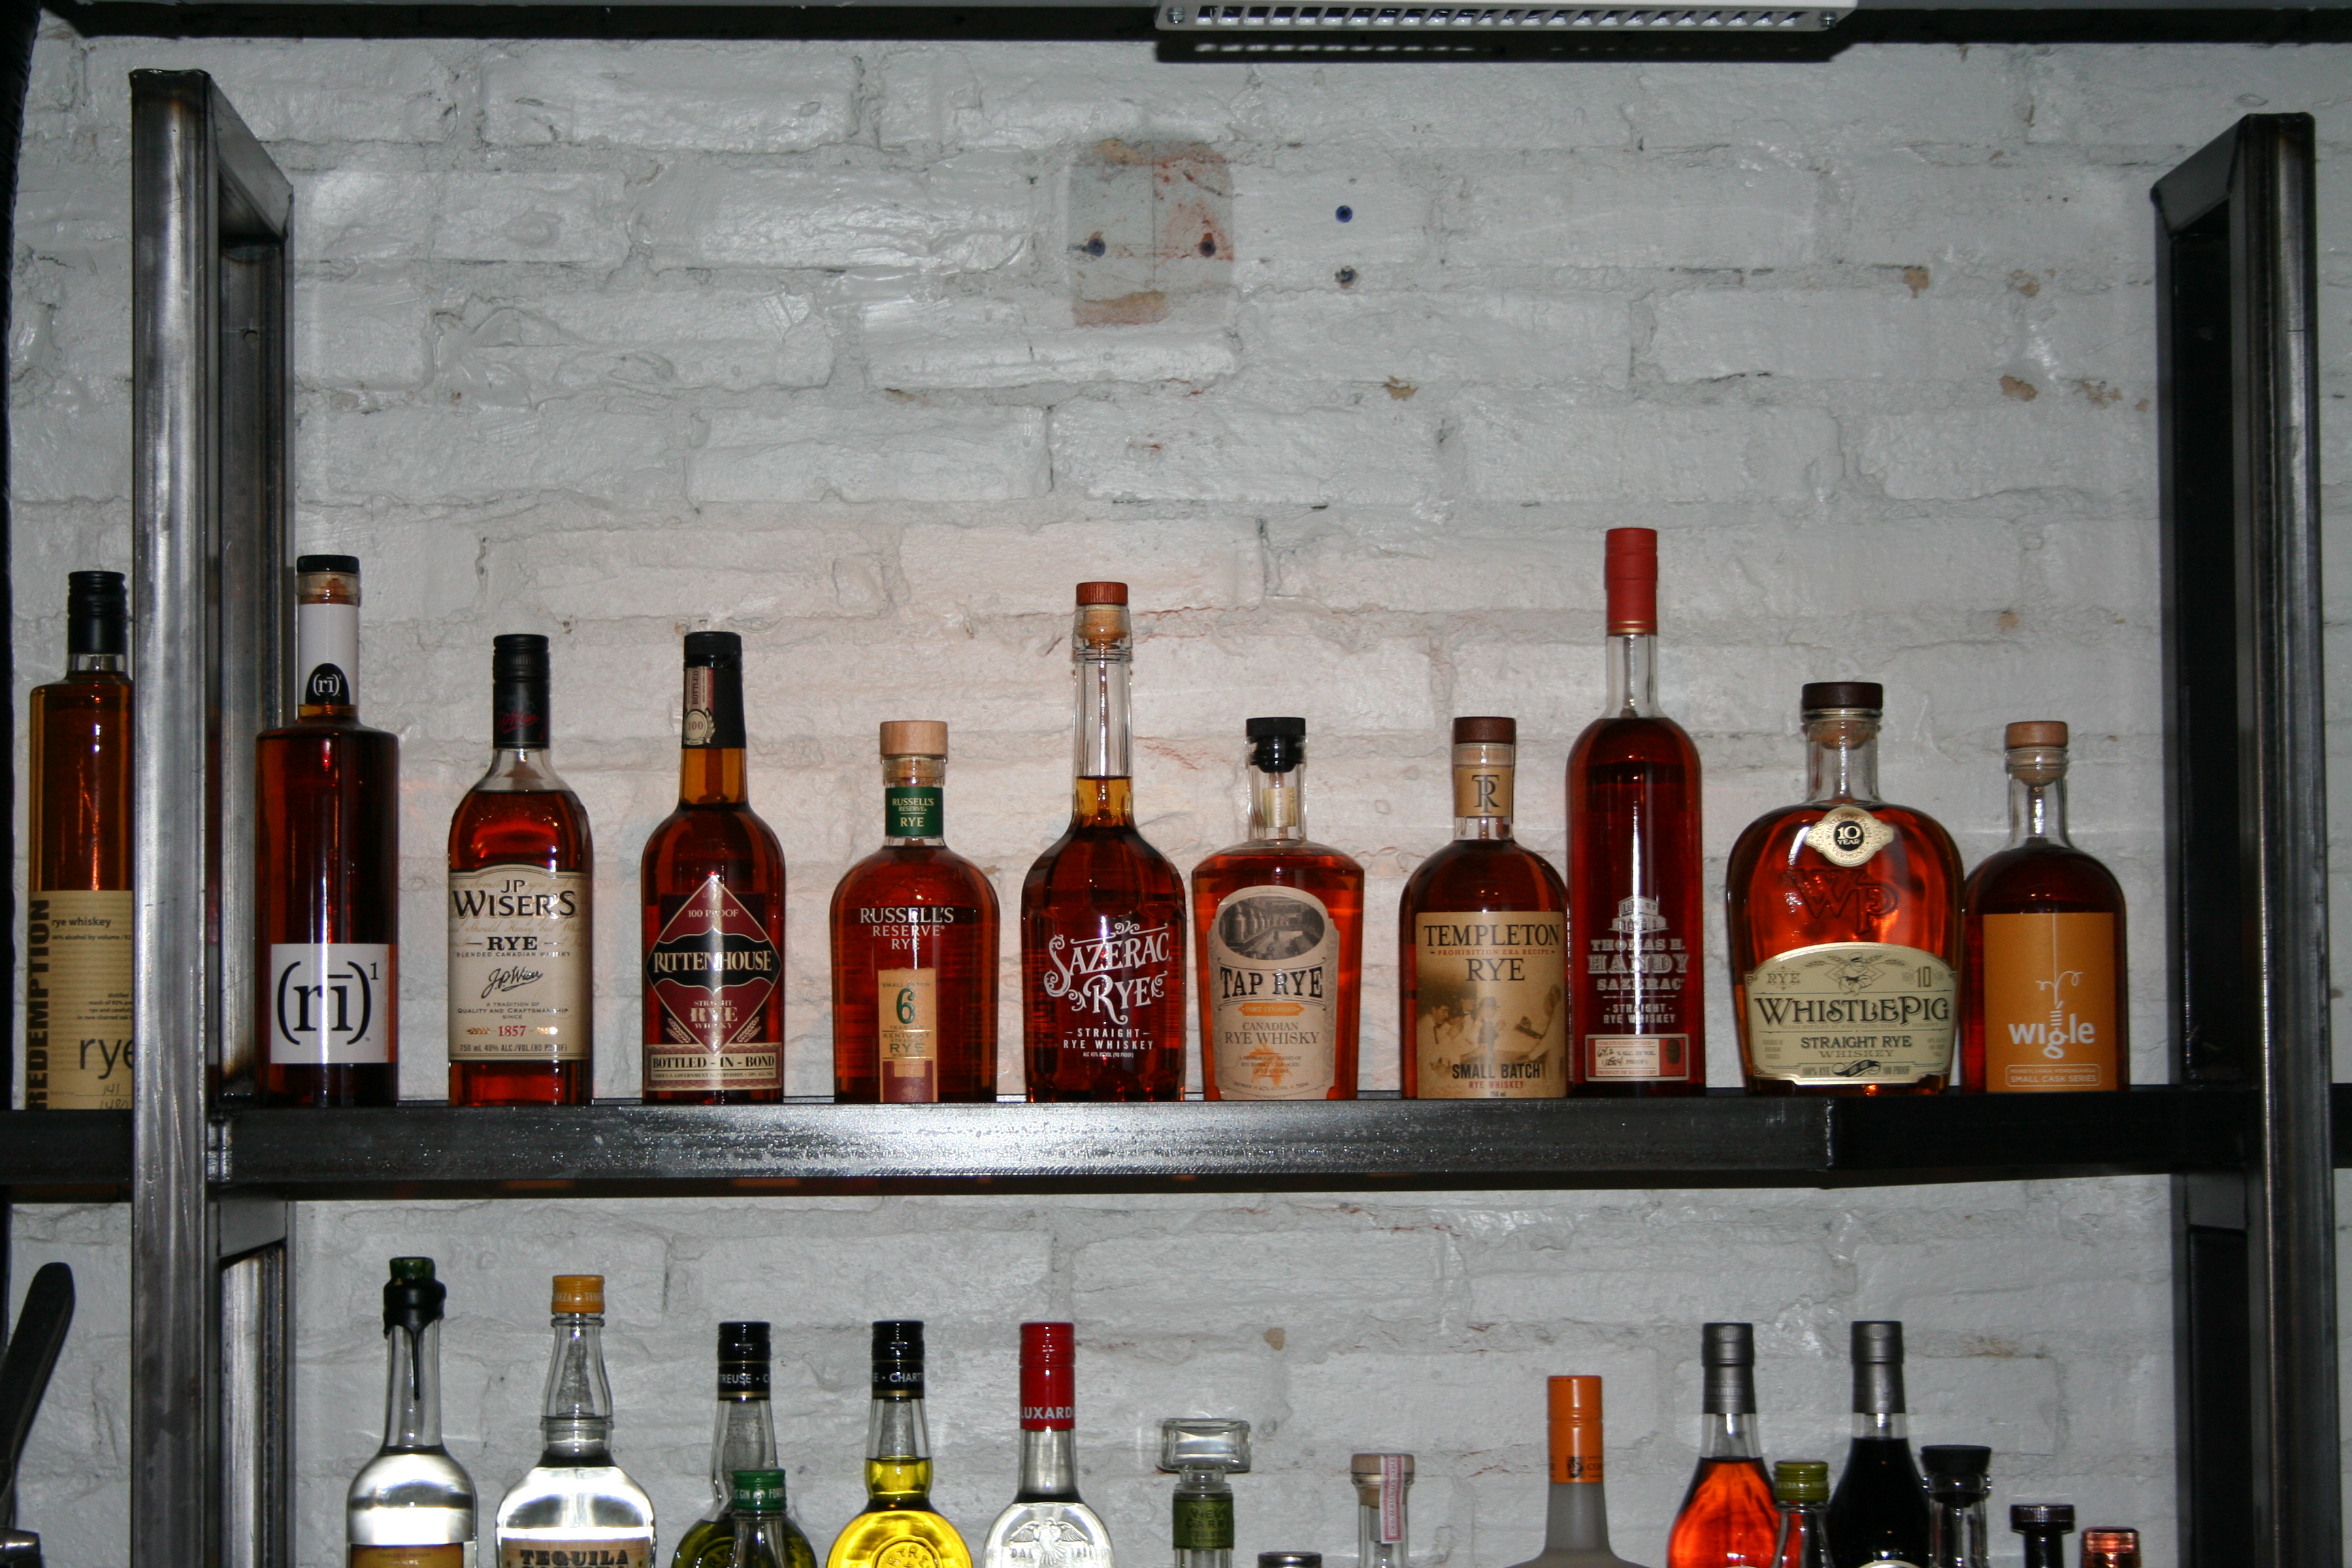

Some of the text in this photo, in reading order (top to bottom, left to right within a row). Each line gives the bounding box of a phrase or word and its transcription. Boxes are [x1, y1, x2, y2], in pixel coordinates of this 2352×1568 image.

[689, 721, 704, 732] 100
[892, 798, 934, 806] RUSSELL'S
[900, 817, 924, 827] RYE
[1838, 826, 1862, 839] 10
[453, 889, 576, 917] WISER'S
[688, 909, 703, 918] 100
[860, 906, 954, 924] RUSSELL'S
[52, 916, 112, 928] rye whiskey
[1424, 924, 1561, 947] TEMPLETON
[487, 936, 538, 951] RYE
[892, 938, 920, 950] RYE
[1669, 938, 1686, 951] H.
[653, 950, 772, 973] RITTENHOUSE
[1043, 932, 1171, 998] SAZERAC
[1587, 953, 1690, 974] HANDY
[1465, 958, 1525, 981] RYE
[1220, 966, 1324, 999] TAP RYE
[1765, 973, 1801, 984] RYE
[1916, 966, 1931, 988] 10
[27, 898, 50, 1110] REDEMPTION
[896, 987, 915, 1024] 6
[1082, 973, 1161, 1026] RYE
[690, 1007, 738, 1022] RYE
[1753, 996, 1950, 1026] WHISTLEPIG
[1603, 1013, 1676, 1024] RYE WISKEY
[497, 1025, 527, 1036] 1857
[1077, 1028, 1141, 1038] STRAIGHT
[1242, 1022, 1299, 1031] CANADIAN
[1063, 1039, 1154, 1050] RYE WHISKEY
[1224, 1031, 1320, 1045] RYE WHISKY
[1800, 1036, 1878, 1049] STRAIGHT
[1881, 1035, 1912, 1048] RYE
[459, 1044, 472, 1052] 750
[889, 1043, 926, 1054] RYE
[1818, 1049, 1895, 1058] WHISKEY
[653, 1055, 774, 1069] BOTTLED IN BOND
[1452, 1063, 1541, 1079] SMALL BATCH
[1468, 1081, 1524, 1089] RYE WHISKEY
[2041, 1075, 2066, 1083] CASK
[1020, 1405, 1075, 1420] UXARD
[520, 1549, 629, 1566] TEQUILA
